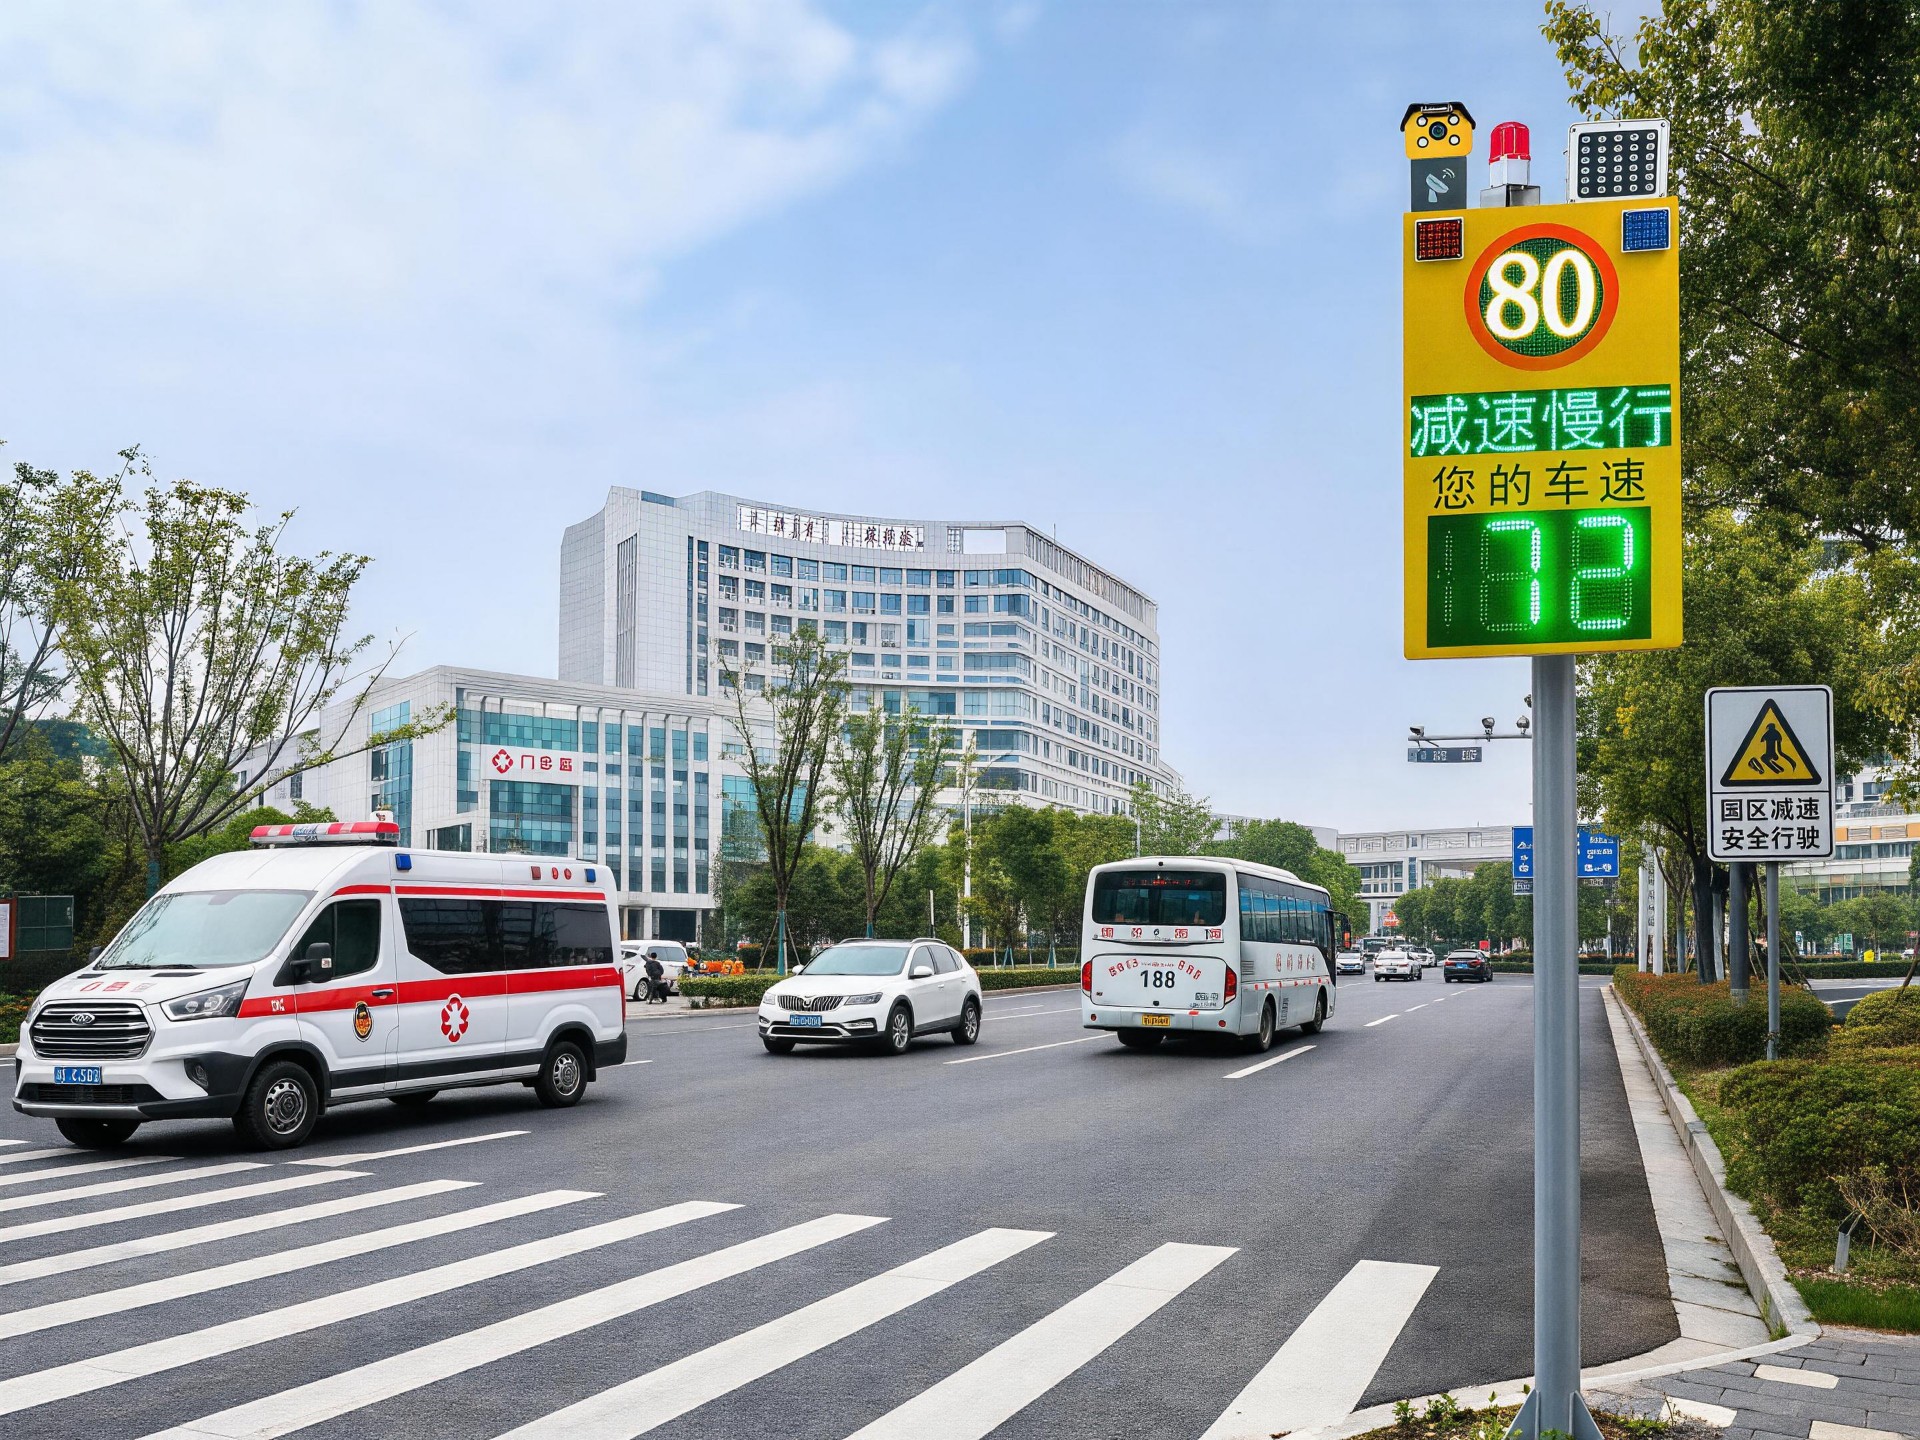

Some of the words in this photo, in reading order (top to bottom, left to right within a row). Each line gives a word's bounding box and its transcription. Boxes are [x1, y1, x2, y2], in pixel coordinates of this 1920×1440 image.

[1484, 249, 1597, 340] 80
[1410, 387, 1672, 457] 减速慢行
[1432, 457, 1646, 510] 您的车速
[1486, 515, 1634, 630] 72
[1721, 825, 1820, 851] 安全行驶
[1140, 969, 1176, 989] 188
